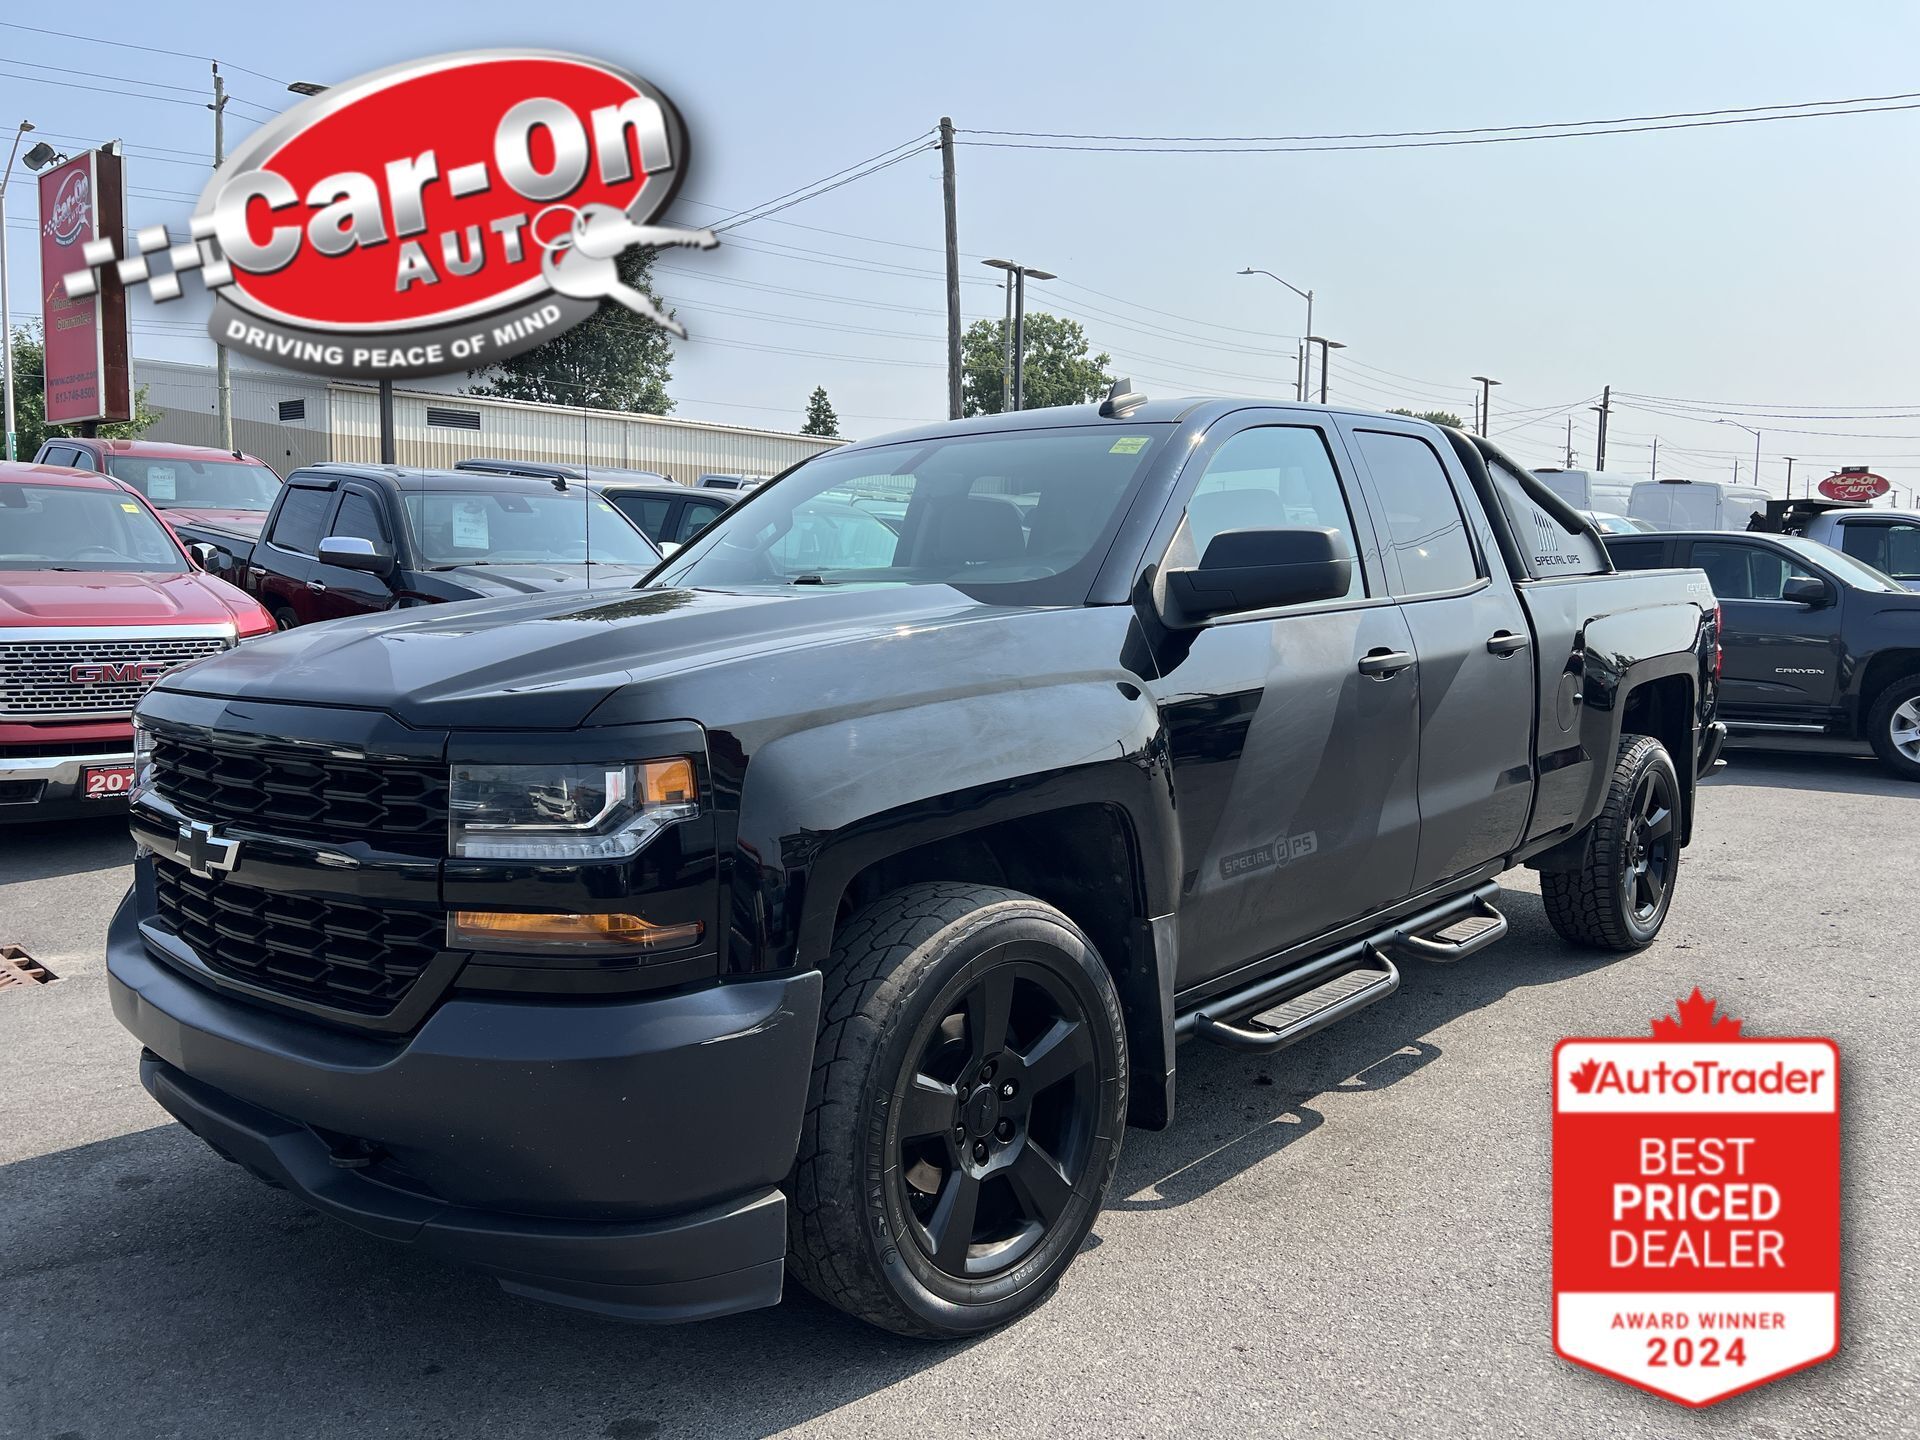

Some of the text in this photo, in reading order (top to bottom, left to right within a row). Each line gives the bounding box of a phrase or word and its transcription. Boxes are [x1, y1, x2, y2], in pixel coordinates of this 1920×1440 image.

[1839, 475, 1878, 485] Car-On
[1534, 554, 1581, 566] SPECIAL OPS
[70, 662, 166, 684] GMC
[1775, 667, 1825, 675] CANYON
[1224, 836, 1312, 873] SPECIAL OPS
